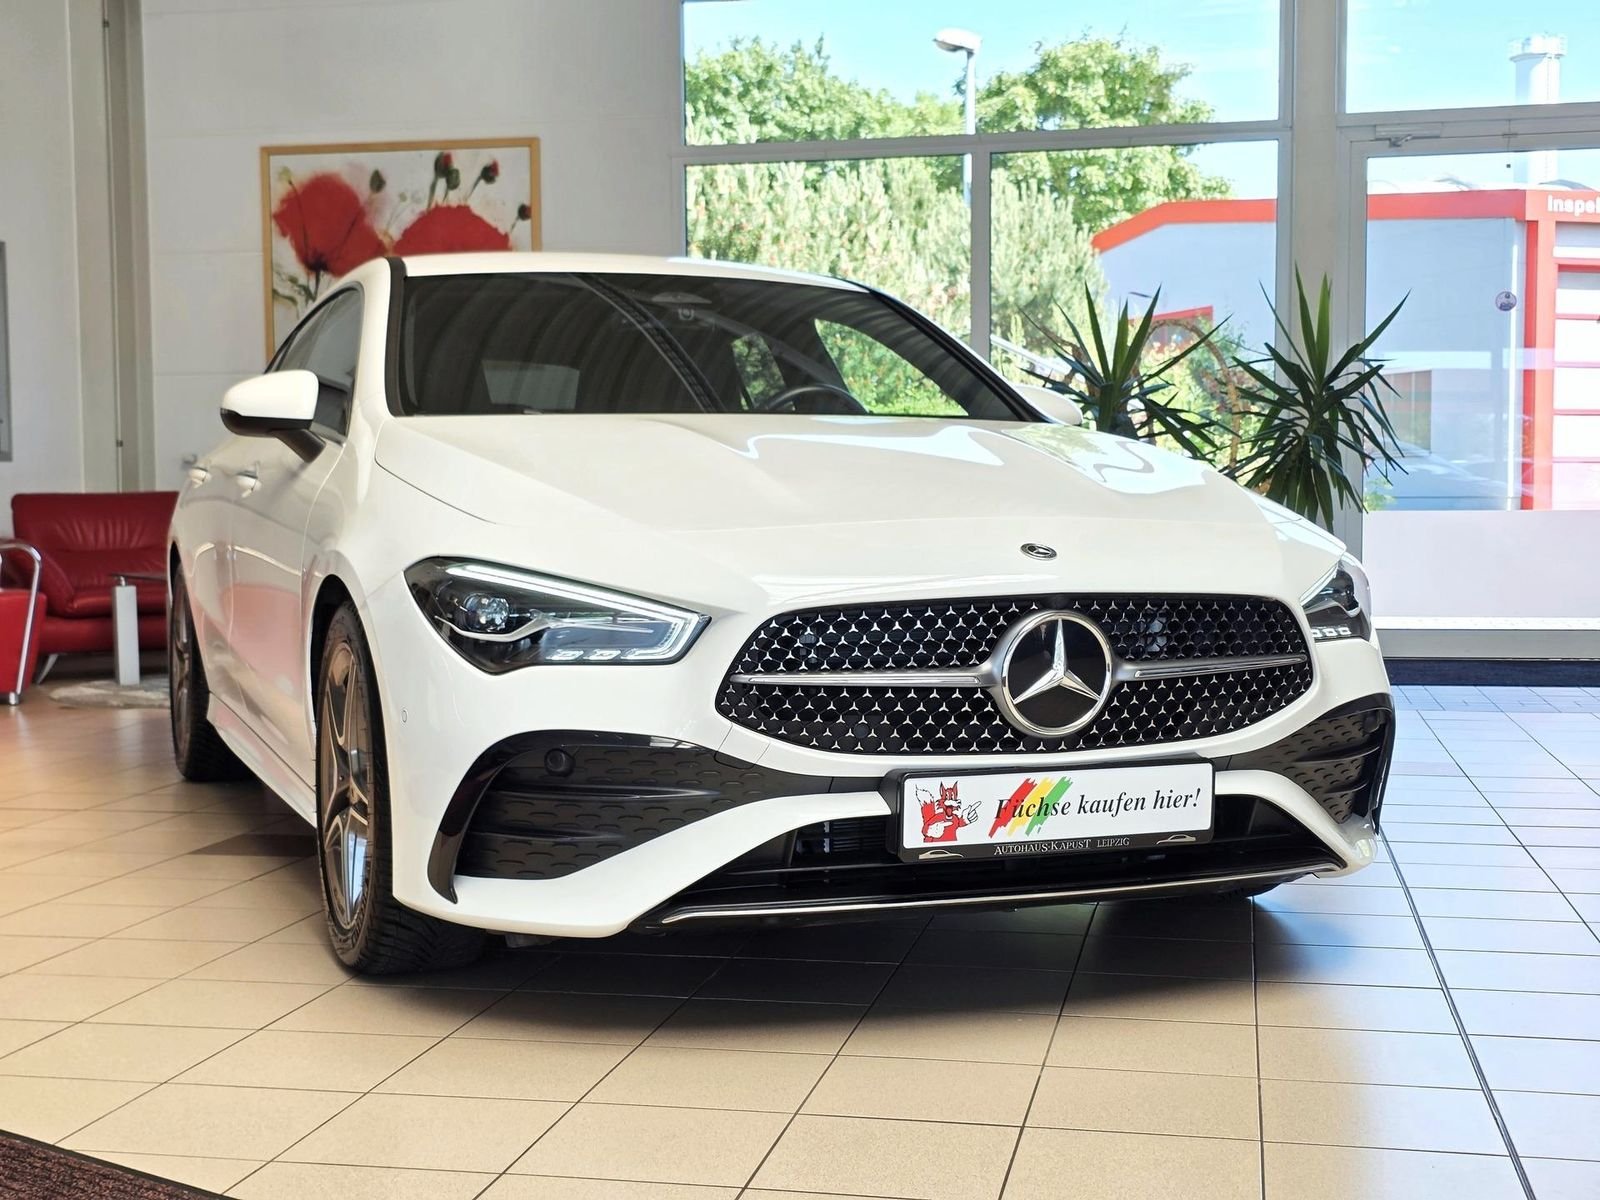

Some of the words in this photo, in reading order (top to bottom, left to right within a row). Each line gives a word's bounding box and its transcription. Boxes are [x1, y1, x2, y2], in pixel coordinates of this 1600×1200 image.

[995, 796, 1070, 818] Füchse
[1077, 792, 1145, 816] kaufen
[1153, 788, 1201, 809] hier!
[1097, 837, 1130, 848] LEIPZIG
